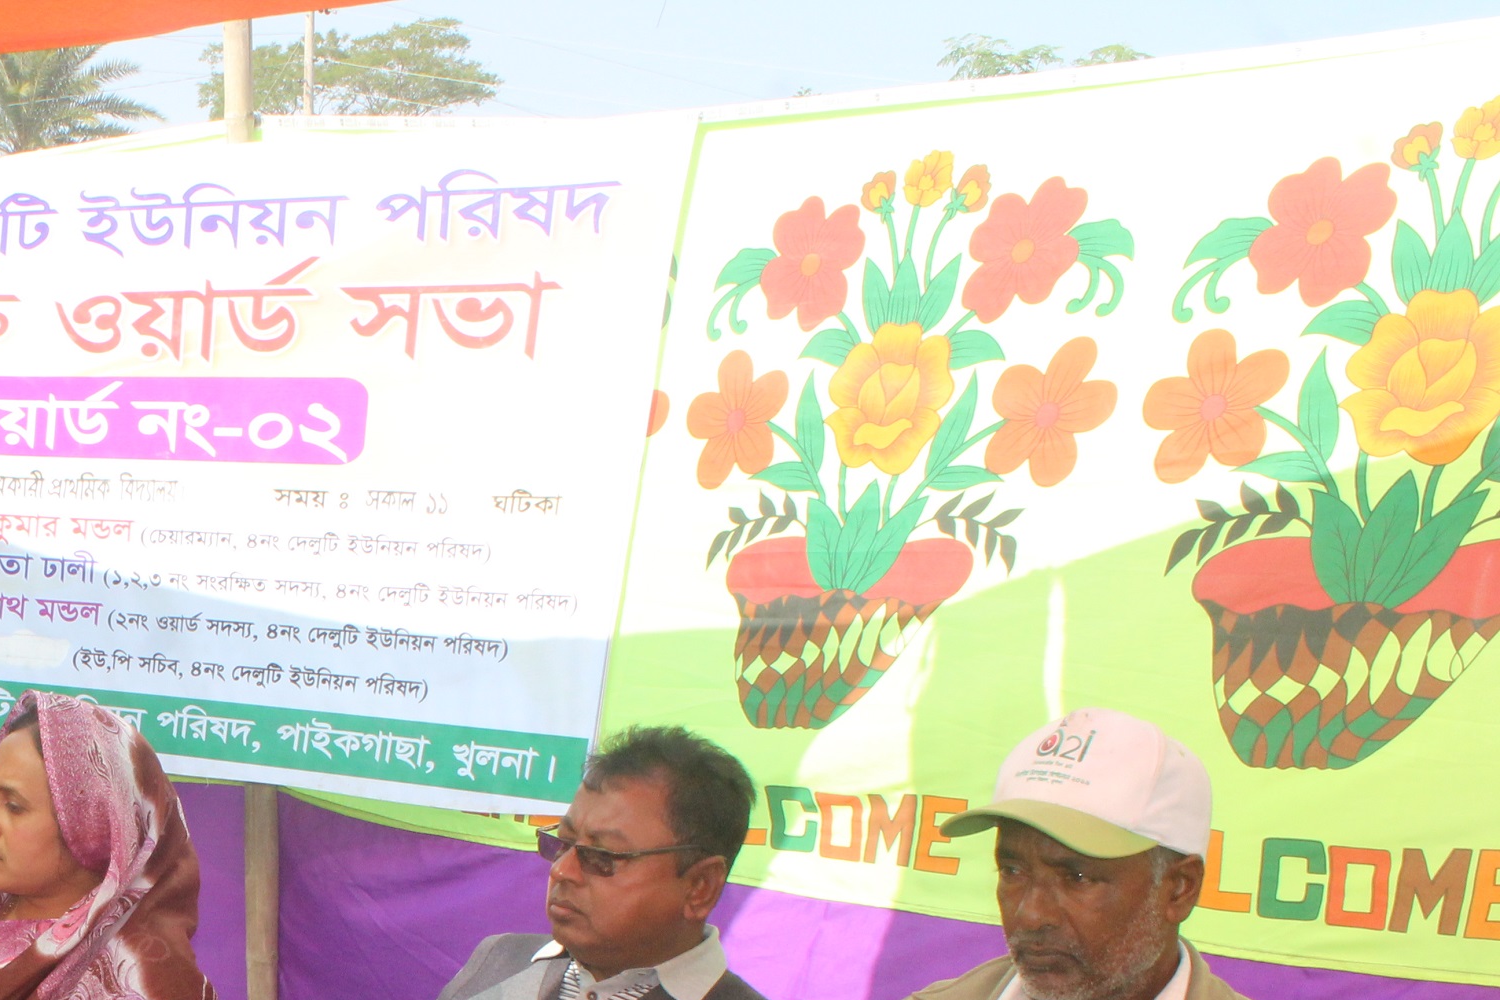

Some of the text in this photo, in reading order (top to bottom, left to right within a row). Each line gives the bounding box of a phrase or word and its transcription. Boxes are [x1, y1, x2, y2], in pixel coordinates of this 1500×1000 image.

[78, 183, 349, 257] ইউনিয়ন
[376, 169, 622, 241] পরিষদ
[56, 256, 319, 363] ওয়ার্ড
[340, 272, 562, 360] সভা
[48, 472, 110, 499] প্রাথমিক
[274, 489, 328, 507] সময়
[367, 490, 416, 509] সকাল
[493, 489, 562, 513] ঘটিকা
[247, 535, 278, 549] ৪নং
[288, 532, 340, 555] দেলুটি
[348, 534, 418, 555] ইউনিয়ন
[43, 551, 96, 584] ঢালী
[170, 574, 188, 590] নং
[197, 572, 265, 592] সংরক্ষিত
[336, 584, 368, 600] ৪নং
[379, 583, 430, 606] দেলুটি
[438, 586, 508, 607] ইউনিয়ন
[156, 612, 202, 632] ওয়ার্ড
[267, 624, 300, 643] ৪নং
[308, 624, 361, 649] দেলুটি
[366, 626, 438, 651] ইউনিয়ন
[191, 662, 225, 681] ৪নং
[232, 663, 284, 688] দেলুটি
[289, 665, 359, 691] ইউনিয়ন
[157, 705, 261, 753] পরিষদ,
[277, 715, 436, 773] পাইকগাছা,
[742, 785, 968, 875] COME
